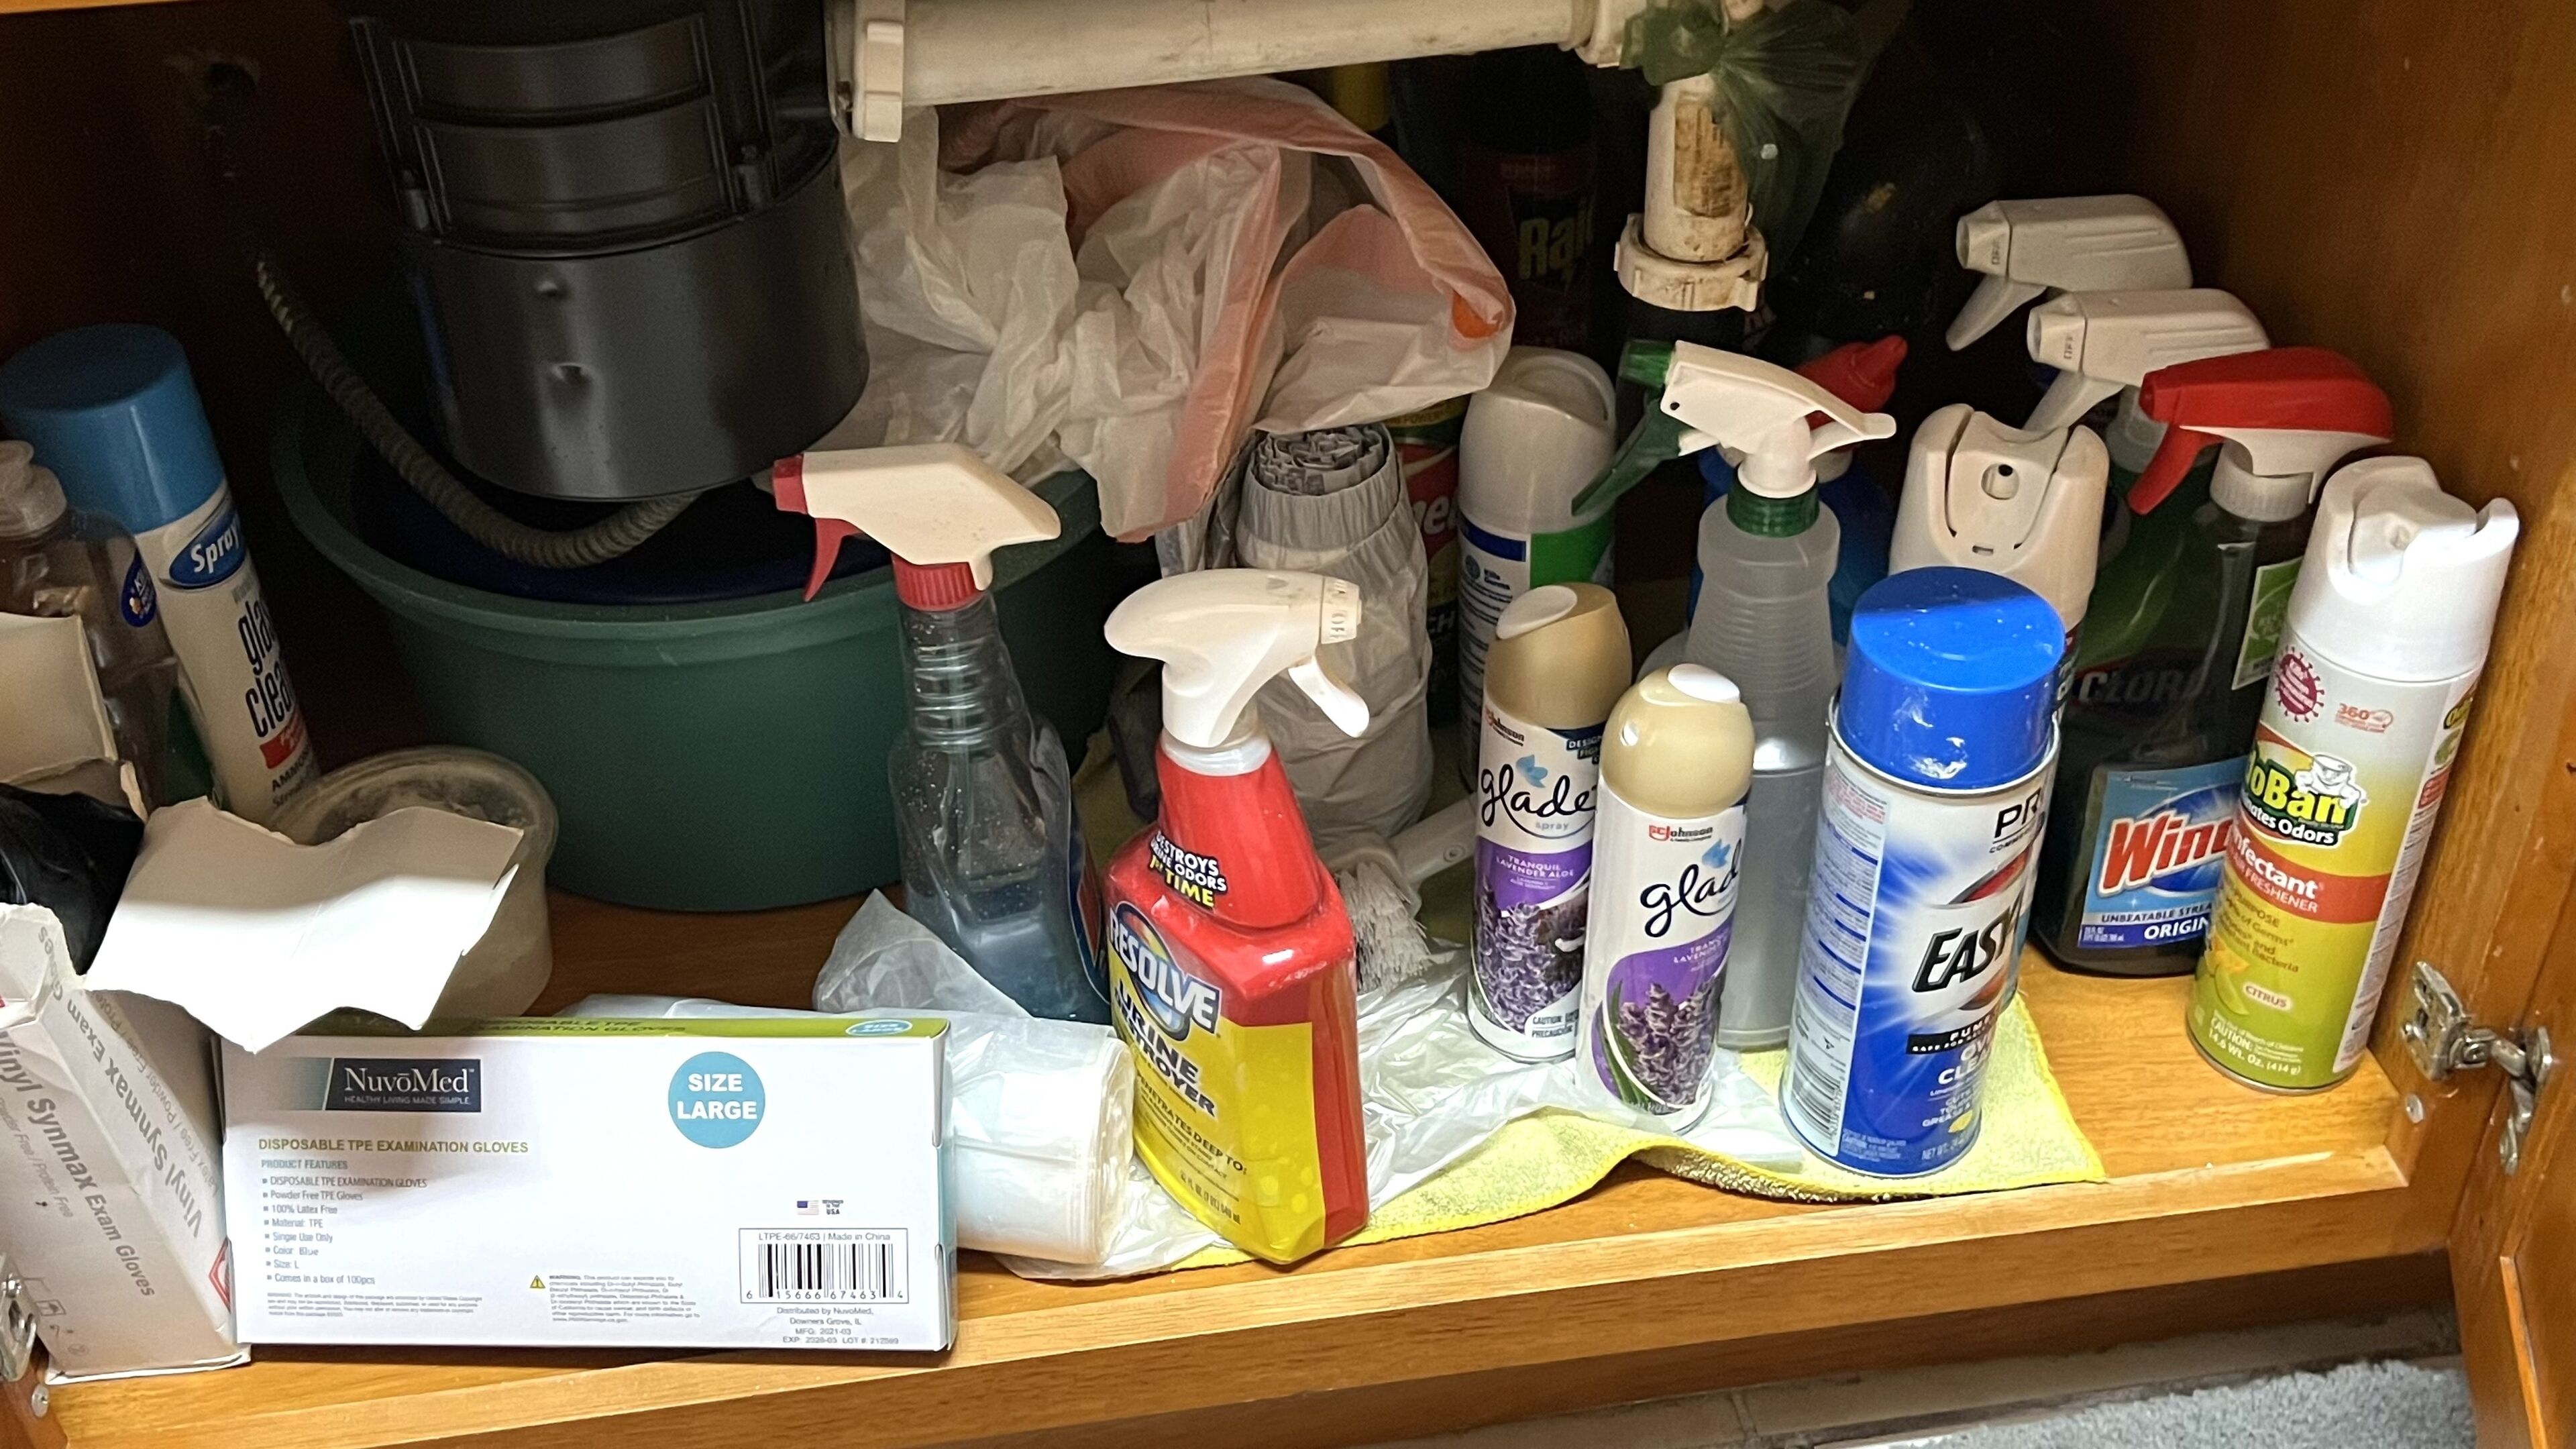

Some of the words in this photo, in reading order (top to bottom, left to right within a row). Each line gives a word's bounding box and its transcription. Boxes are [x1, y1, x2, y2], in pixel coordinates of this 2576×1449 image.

[238, 599, 276, 676] gla
[246, 661, 294, 738] clea
[1536, 822, 1569, 831] spray
[2278, 819, 2334, 844] Odors
[1496, 855, 1546, 877] LAVENDER
[1548, 869, 1574, 878] ALOE
[1508, 854, 1561, 871] TRANQUIL
[1165, 868, 1214, 907] TIME
[1175, 863, 1227, 892] ODORS
[1640, 838, 1741, 937] glad
[2246, 868, 2318, 913] FRESHENER
[2101, 909, 2174, 923] UNBEATABLE
[2144, 916, 2210, 940] ORIGIN
[1109, 910, 1217, 1030] RESOLVE
[2245, 985, 2287, 1008] CITRUS
[67, 998, 106, 1063] Exam
[1119, 978, 1199, 1085] URINE
[688, 1073, 744, 1092] SIZE
[344, 1095, 381, 1104] HEALTHY
[383, 1096, 411, 1104] LIVING
[412, 1097, 437, 1105] MADE
[439, 1097, 470, 1106] SIMPLE
[677, 1100, 758, 1120] LARGE
[105, 1057, 168, 1171] Synmax
[259, 1138, 345, 1151] DISPOSABLE
[347, 1140, 373, 1152] TPE
[377, 1140, 470, 1153] EXAMINATION
[472, 1141, 529, 1154] GLOVES
[1193, 1132, 1224, 1158] DEEP
[261, 1159, 301, 1169] PRODUCT
[304, 1160, 348, 1170] FEATURES
[270, 1176, 319, 1186] DISPOSABLE
[321, 1177, 335, 1186] TPE
[337, 1177, 394, 1187] EXAMINATION
[395, 1179, 428, 1188] GLOVES
[27, 1097, 97, 1193] Synmax
[85, 1194, 121, 1242] Exam
[115, 1244, 155, 1297] Gloves
[165, 1163, 202, 1238] Vinyl
[270, 1190, 301, 1199] Powder
[302, 1191, 319, 1199] Free
[321, 1192, 335, 1200] TPE
[337, 1191, 364, 1201] Gloves
[272, 1204, 294, 1214] 100%
[297, 1205, 318, 1214] Latex
[320, 1205, 337, 1214] Free
[309, 1218, 323, 1228] TPE
[272, 1232, 297, 1242] Single
[299, 1232, 313, 1241] Use
[315, 1232, 333, 1244] Only
[828, 1233, 853, 1241] Made
[855, 1233, 863, 1241] in
[865, 1232, 891, 1241] China
[299, 1246, 319, 1256] Blue
[274, 1273, 301, 1282] Comes
[320, 1274, 334, 1283] box
